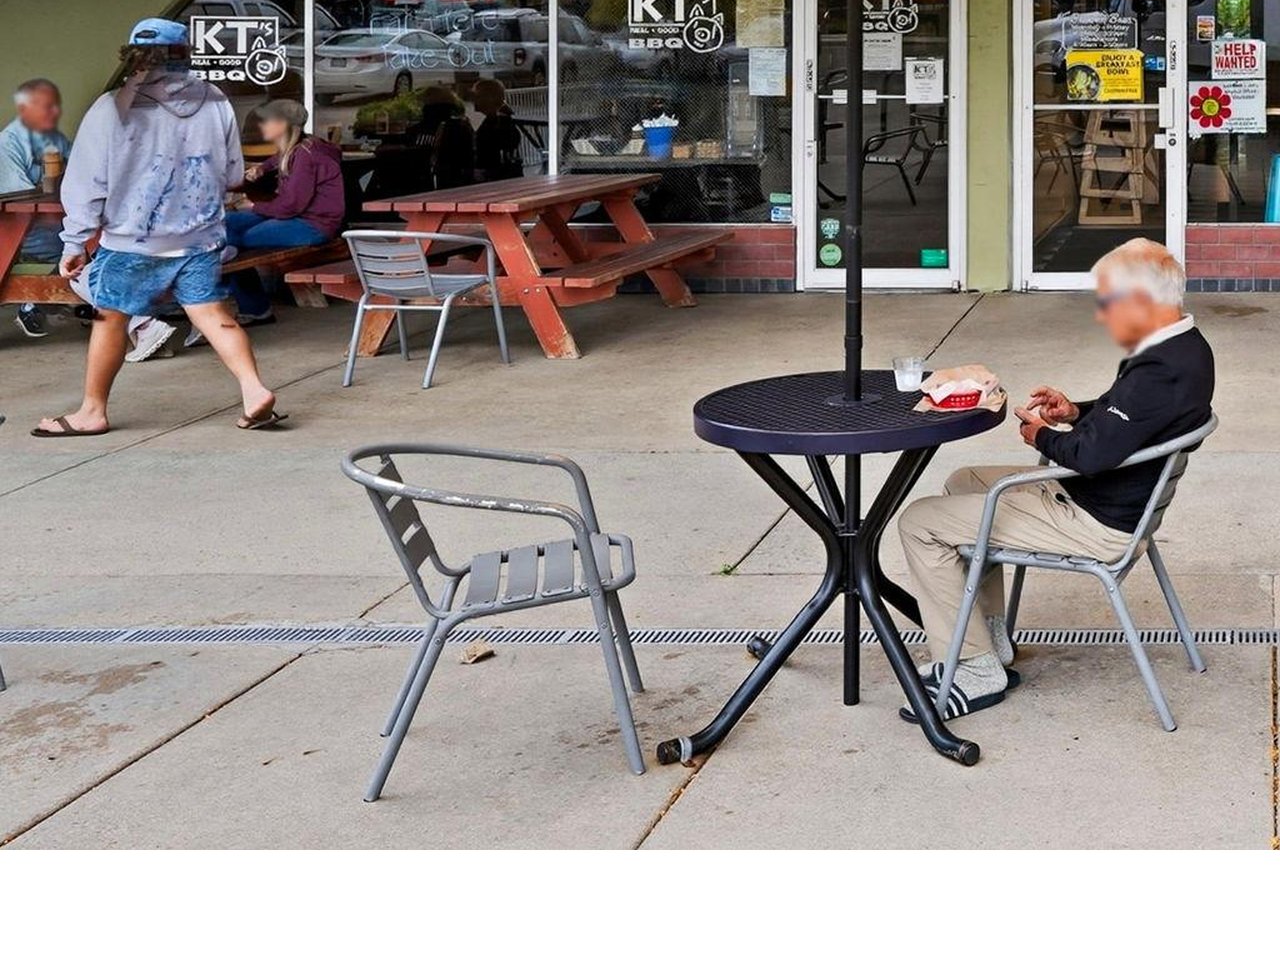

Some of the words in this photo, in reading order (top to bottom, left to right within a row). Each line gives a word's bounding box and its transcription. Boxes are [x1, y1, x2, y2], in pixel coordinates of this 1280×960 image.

[862, 21, 889, 31] BQ
[628, 38, 684, 49] BBQ
[1224, 43, 1257, 56] HELP
[1215, 56, 1257, 69] WANTED
[190, 70, 246, 81] BBQ
